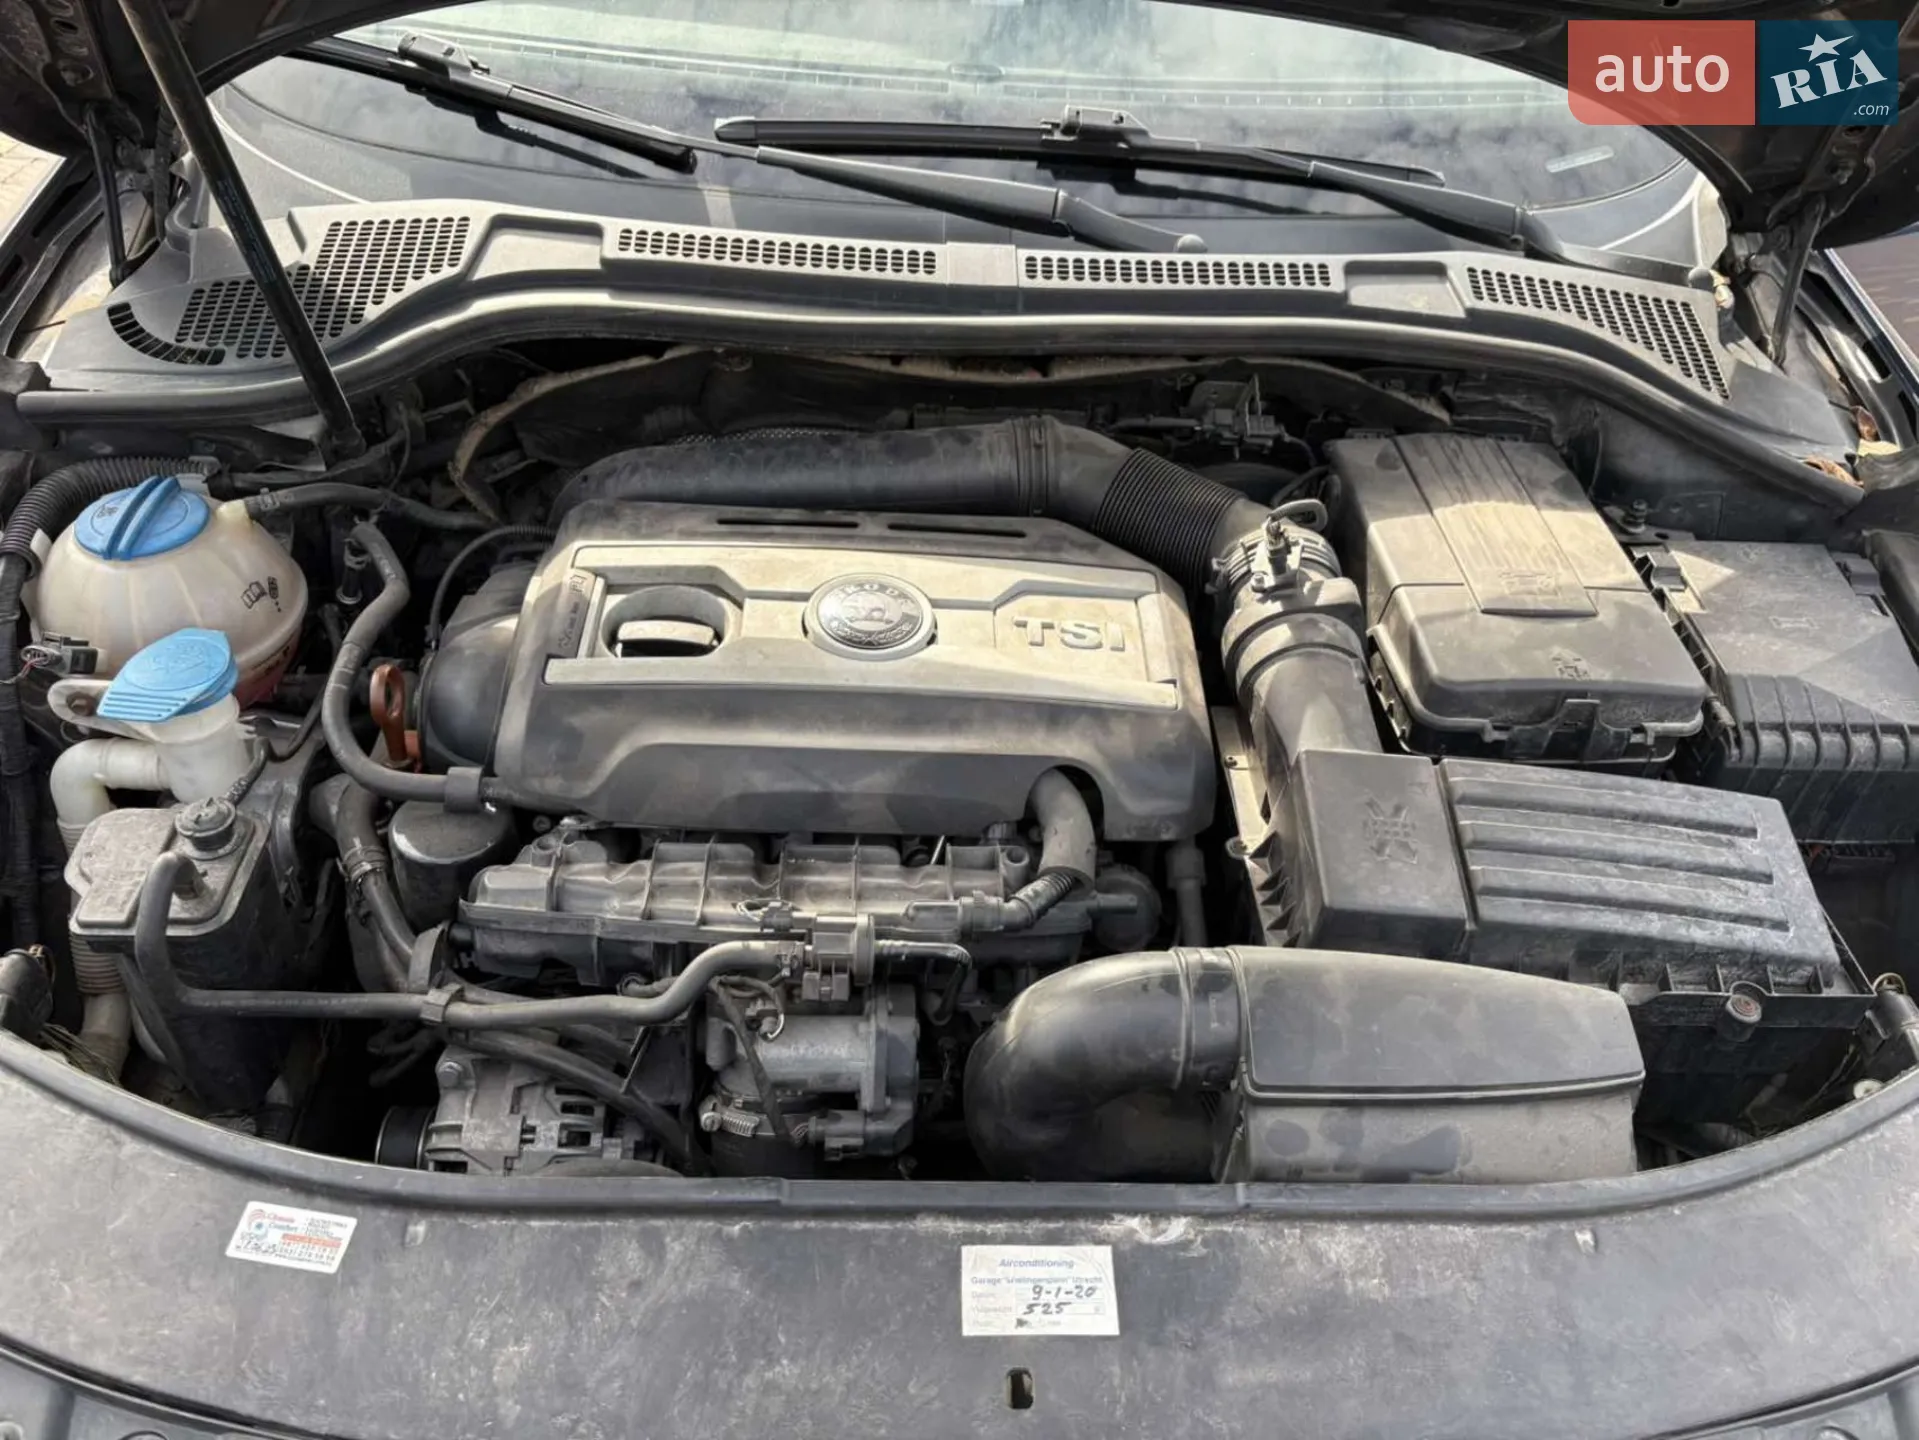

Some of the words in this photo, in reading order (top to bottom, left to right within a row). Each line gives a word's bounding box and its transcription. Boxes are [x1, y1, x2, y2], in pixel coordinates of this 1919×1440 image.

[1014, 615, 1126, 652] TSI
[999, 1258, 1075, 1269] Airconditioning
[1032, 1284, 1098, 1301] 9-1-20
[1022, 1301, 1073, 1316] 525
